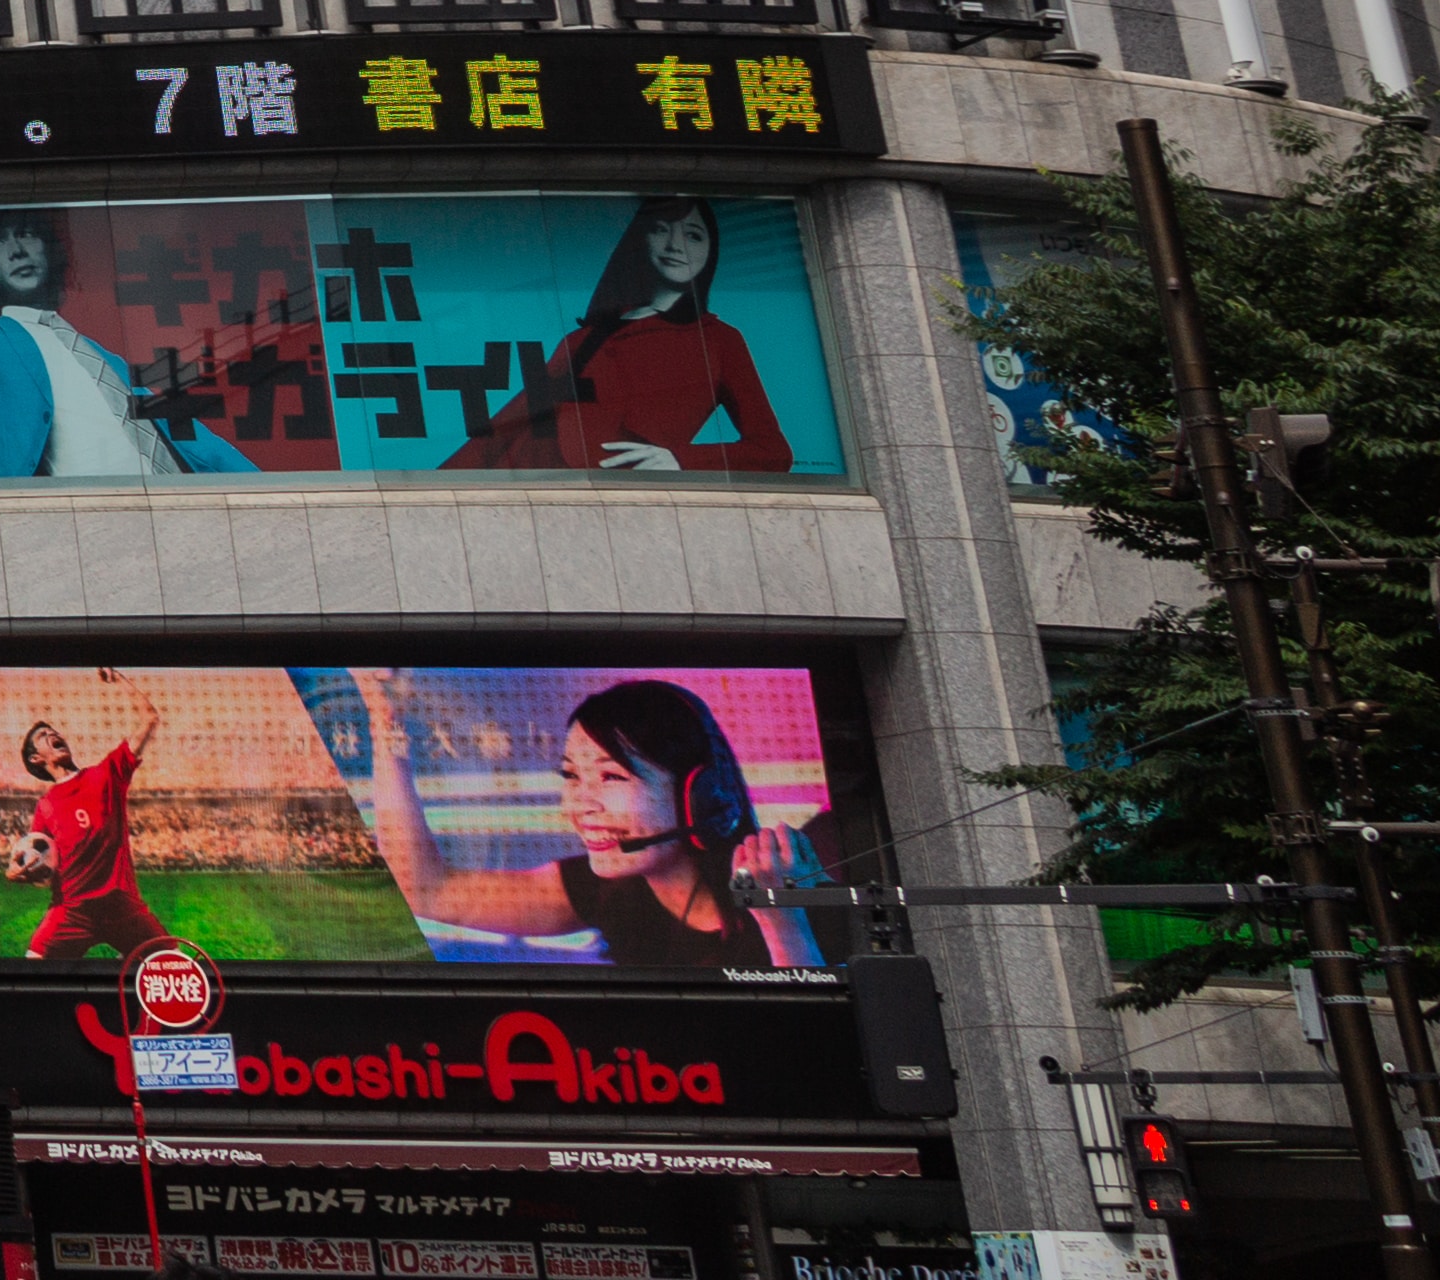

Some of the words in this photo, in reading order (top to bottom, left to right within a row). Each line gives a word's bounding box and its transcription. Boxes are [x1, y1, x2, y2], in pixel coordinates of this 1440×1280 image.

[73, 809, 89, 827] 9
[721, 966, 839, 986] Yodobashi-Vision
[142, 974, 204, 1003] 消火栓
[134, 1038, 230, 1051] ギリシャ式マッサージの
[158, 1051, 231, 1074] アイーア
[548, 1151, 658, 1169] ヨドバシカメラ
[660, 1155, 736, 1170] マルチメディア
[165, 1185, 367, 1215] ヨドバシカメラ
[374, 1194, 512, 1216] マルチメディア
